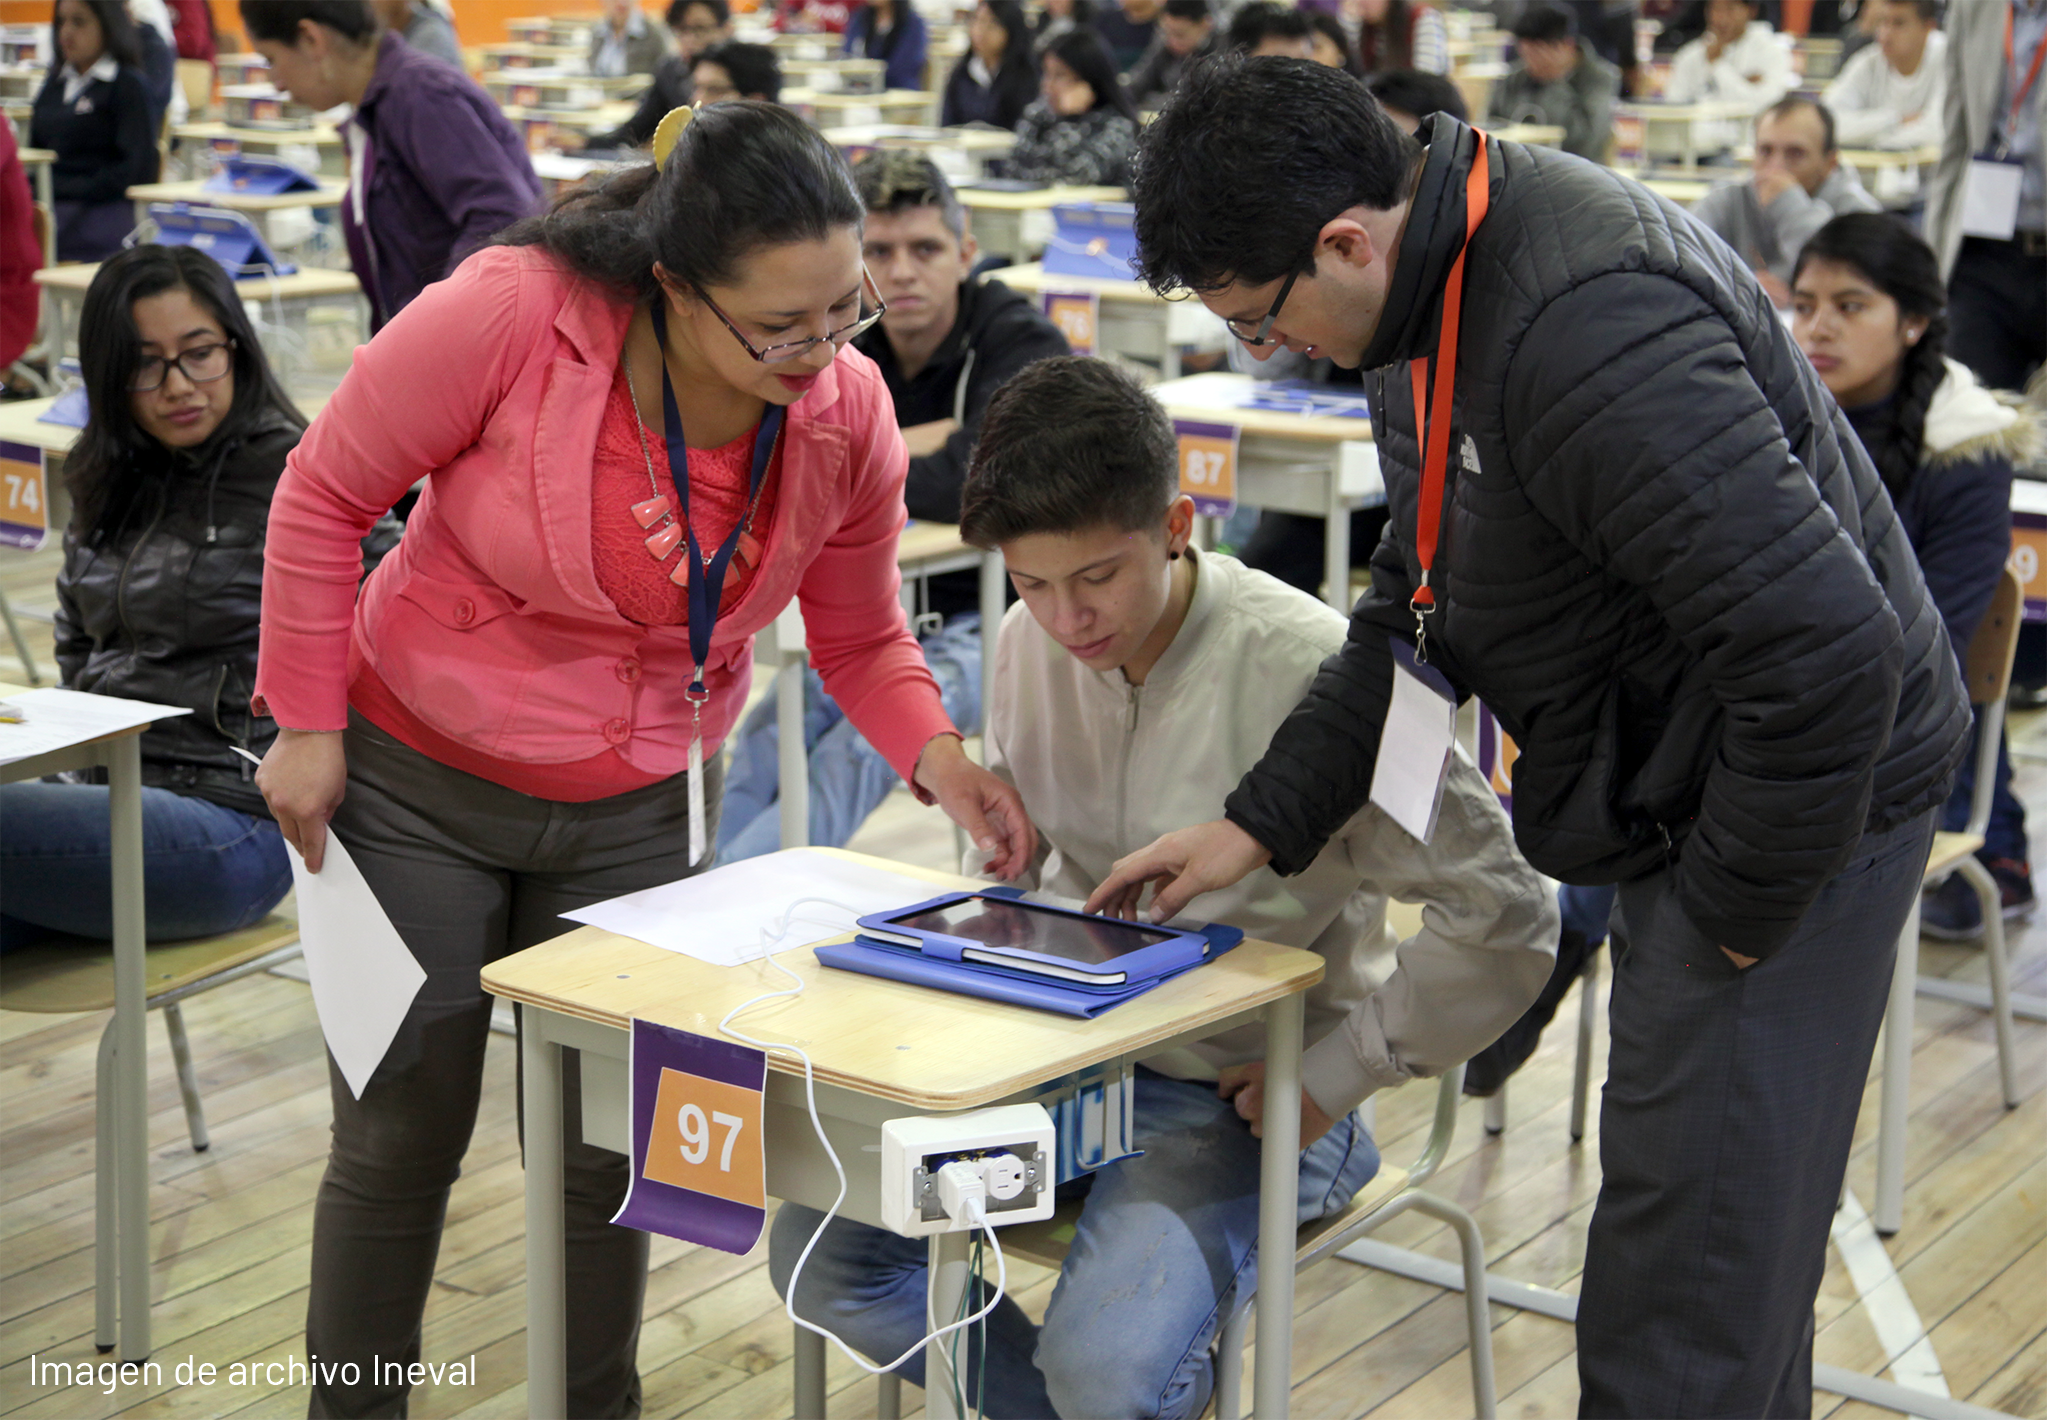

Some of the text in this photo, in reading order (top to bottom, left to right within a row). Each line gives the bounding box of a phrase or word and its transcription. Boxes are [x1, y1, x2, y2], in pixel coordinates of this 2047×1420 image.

[1186, 449, 1226, 486] 87
[4, 474, 40, 514] 74
[677, 1103, 744, 1173] 97
